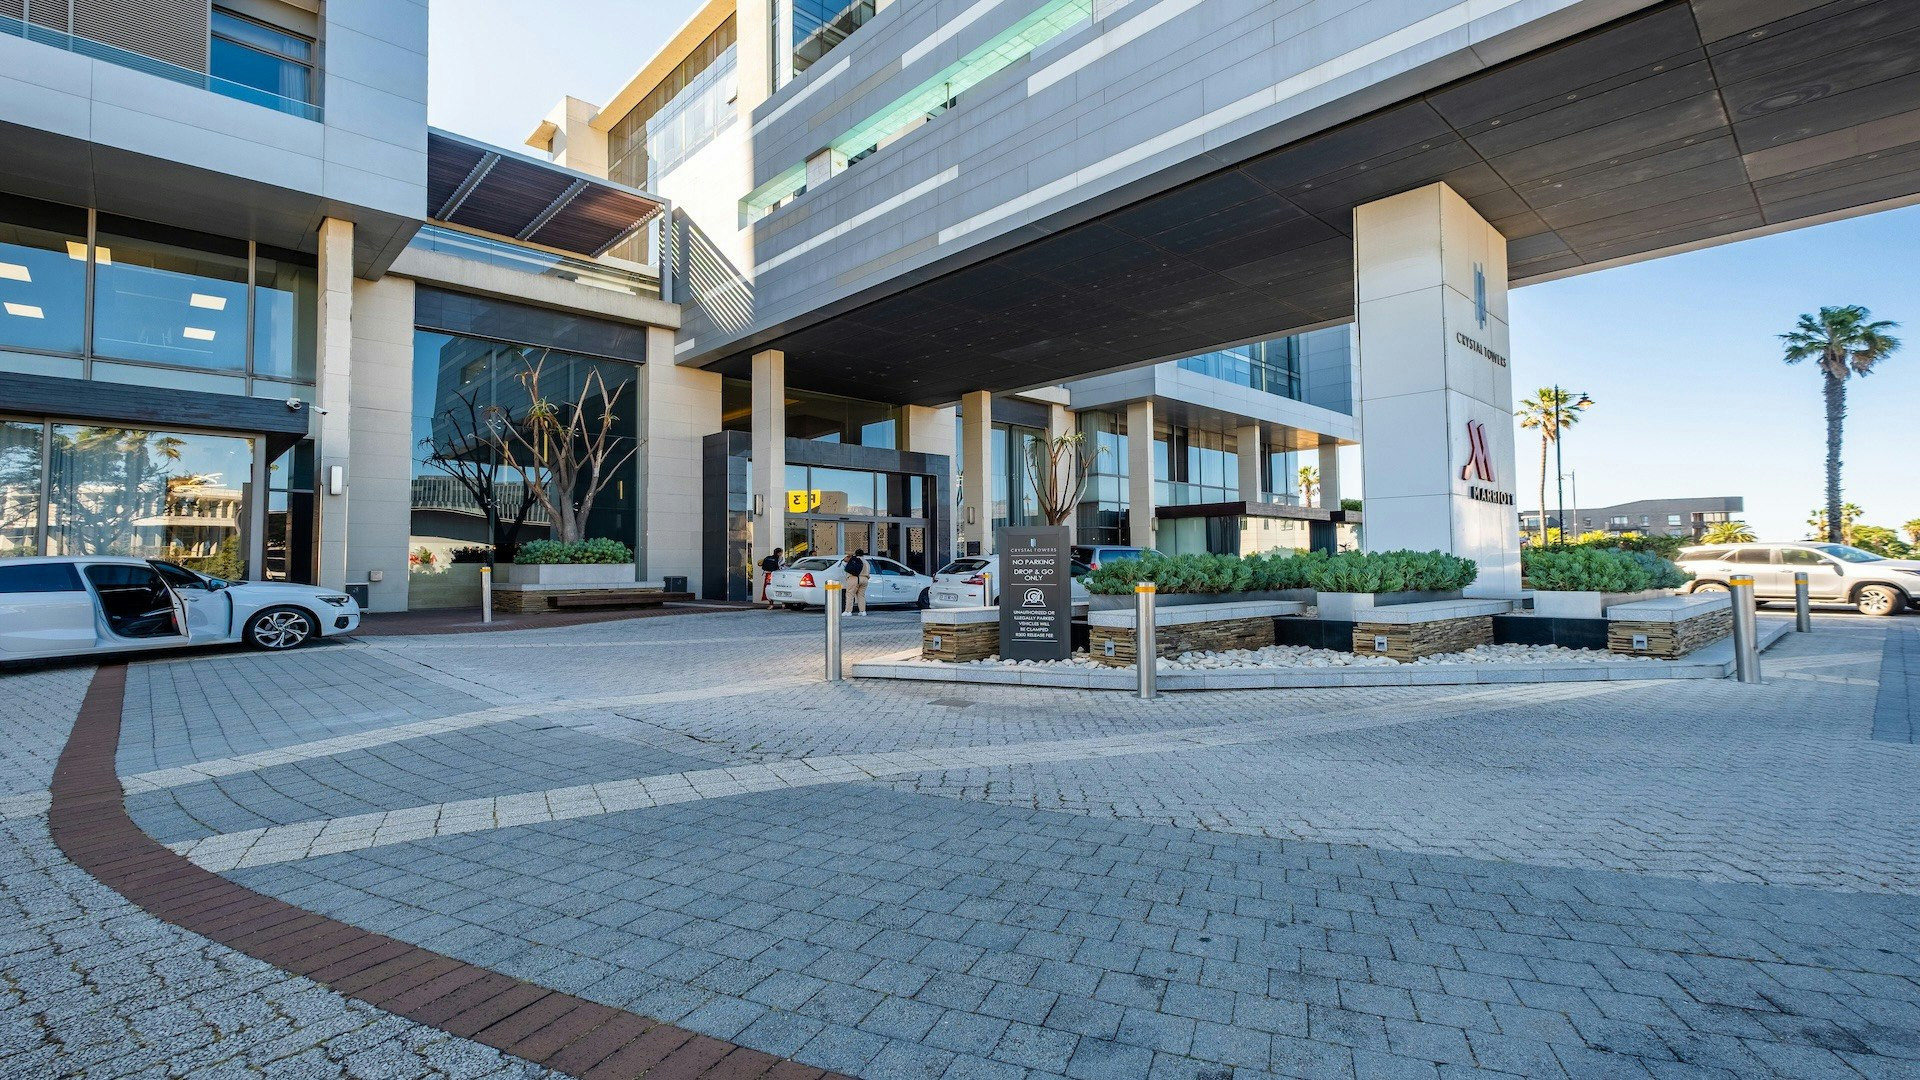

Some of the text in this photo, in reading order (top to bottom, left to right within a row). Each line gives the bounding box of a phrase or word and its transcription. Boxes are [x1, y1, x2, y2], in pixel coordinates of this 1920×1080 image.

[1456, 332, 1506, 368] CRYSTAL TOWERS
[1470, 486, 1514, 506] MARRIOTT
